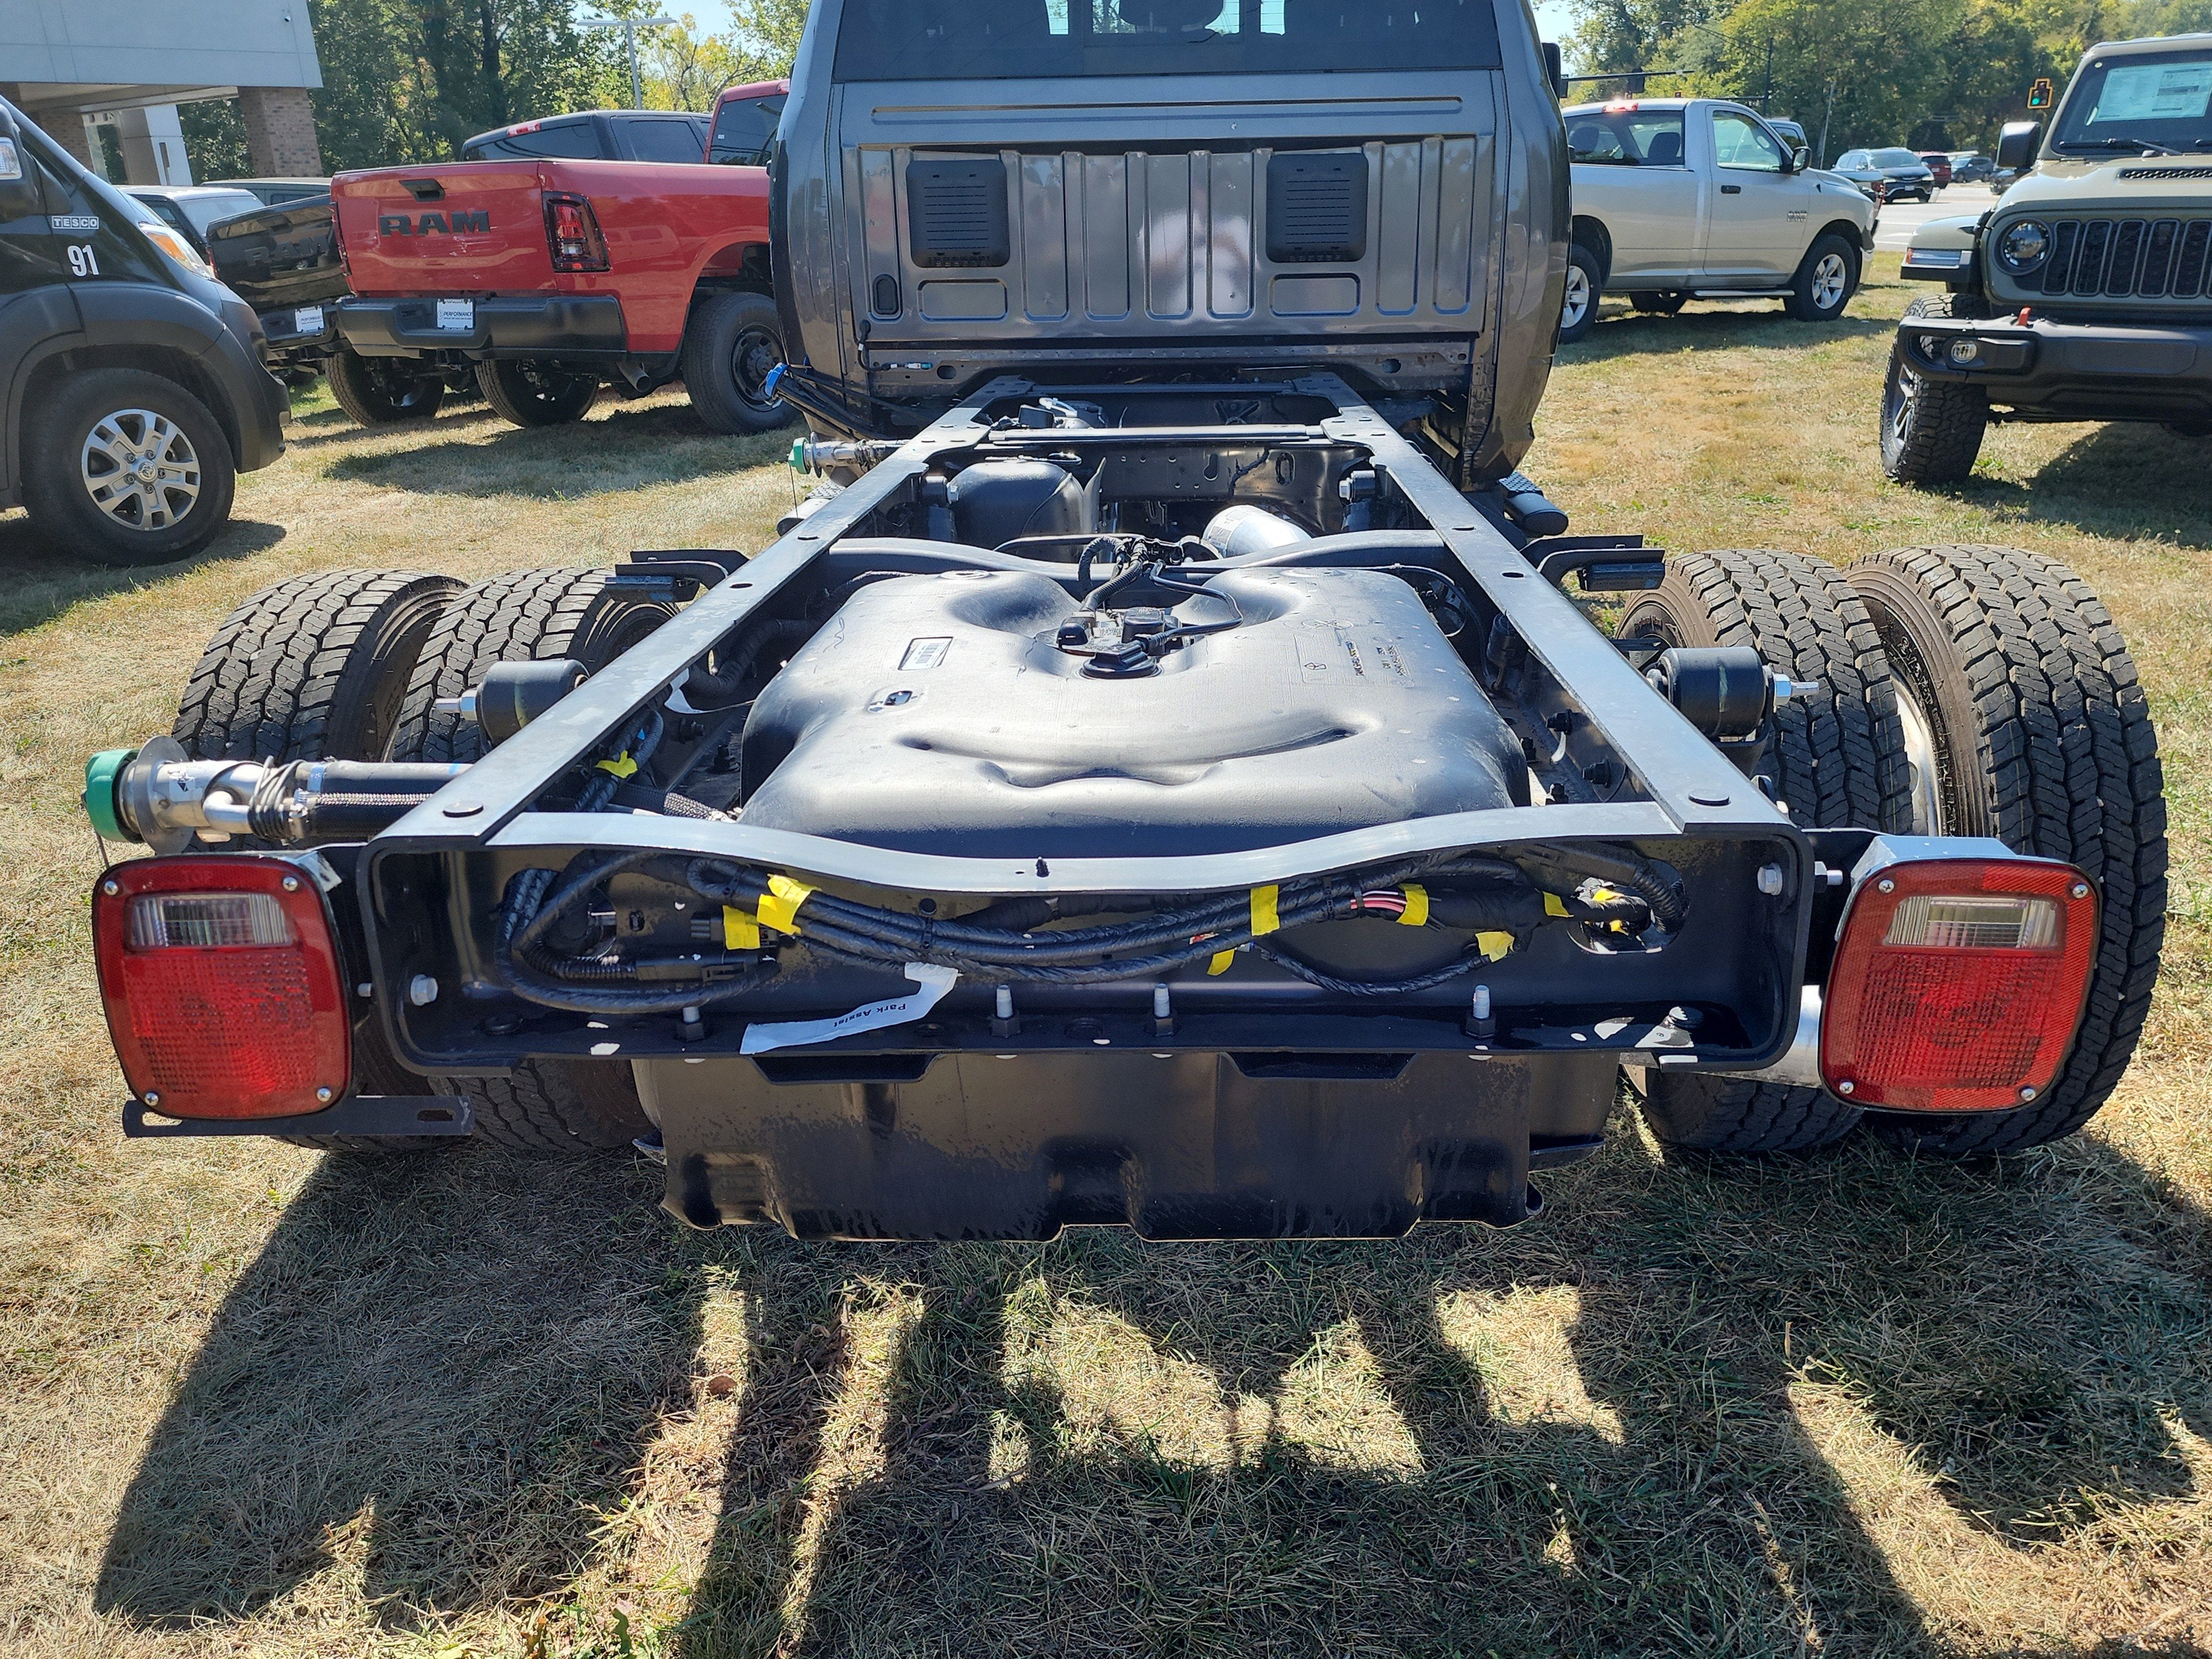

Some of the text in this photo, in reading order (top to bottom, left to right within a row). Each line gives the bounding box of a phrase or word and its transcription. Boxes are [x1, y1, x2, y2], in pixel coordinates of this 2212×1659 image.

[53, 217, 98, 228] TESCO
[379, 211, 491, 237] RAM
[67, 244, 99, 276] 91
[244, 234, 330, 267] RAM
[833, 1003, 906, 1027] Park Assist
